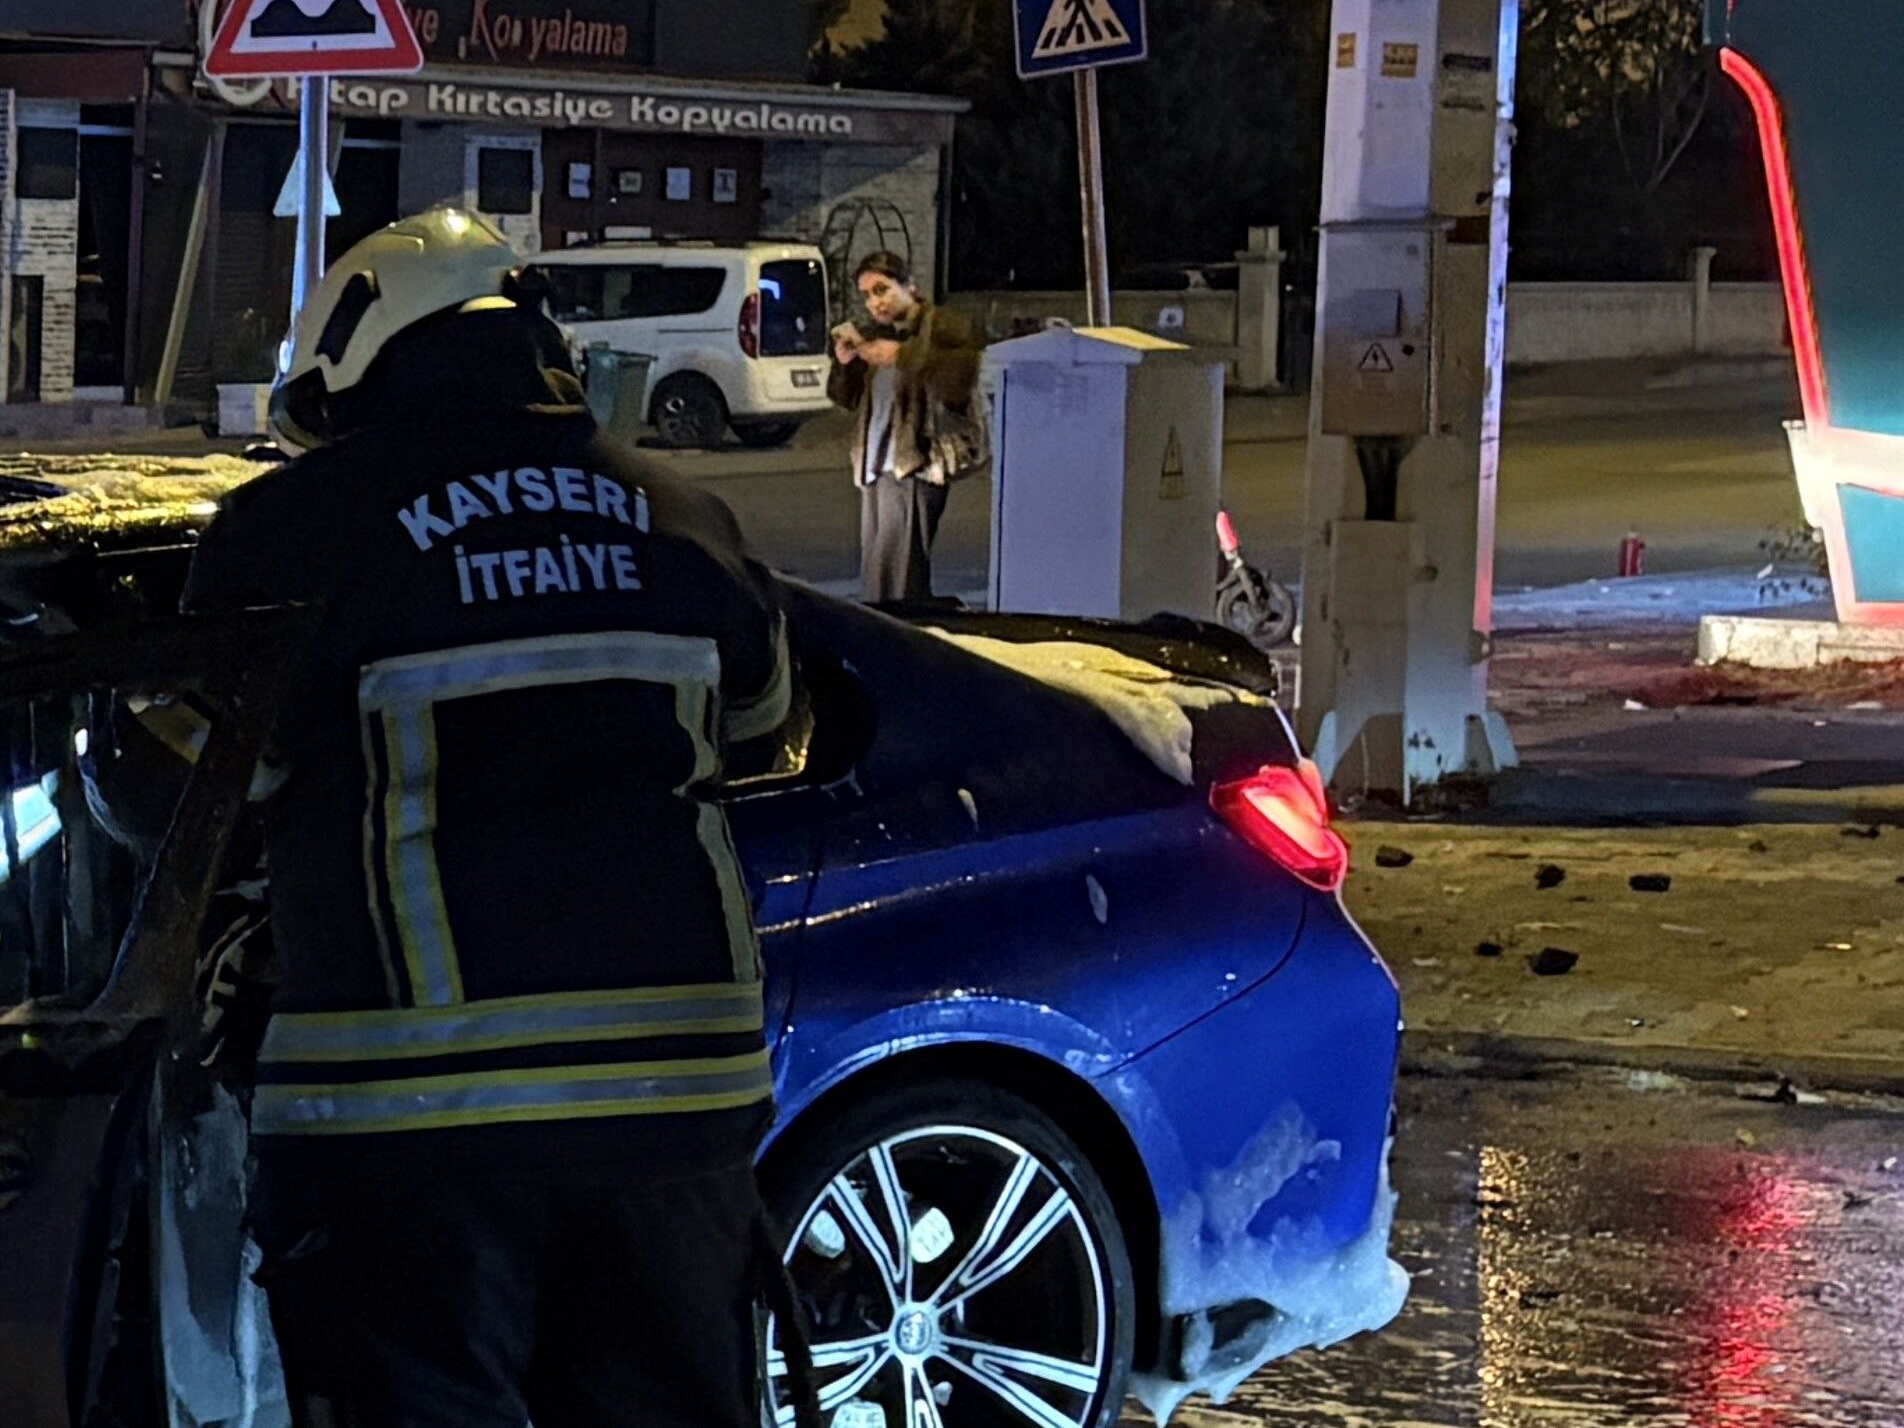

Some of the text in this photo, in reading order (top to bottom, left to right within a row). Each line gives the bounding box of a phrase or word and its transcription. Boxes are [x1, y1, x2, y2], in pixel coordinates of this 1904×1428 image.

[427, 83, 614, 125] Kırtasiye
[630, 96, 853, 134] Kopyalama
[397, 467, 650, 551] KAYSERİ
[453, 533, 643, 604] İTFAİYE
